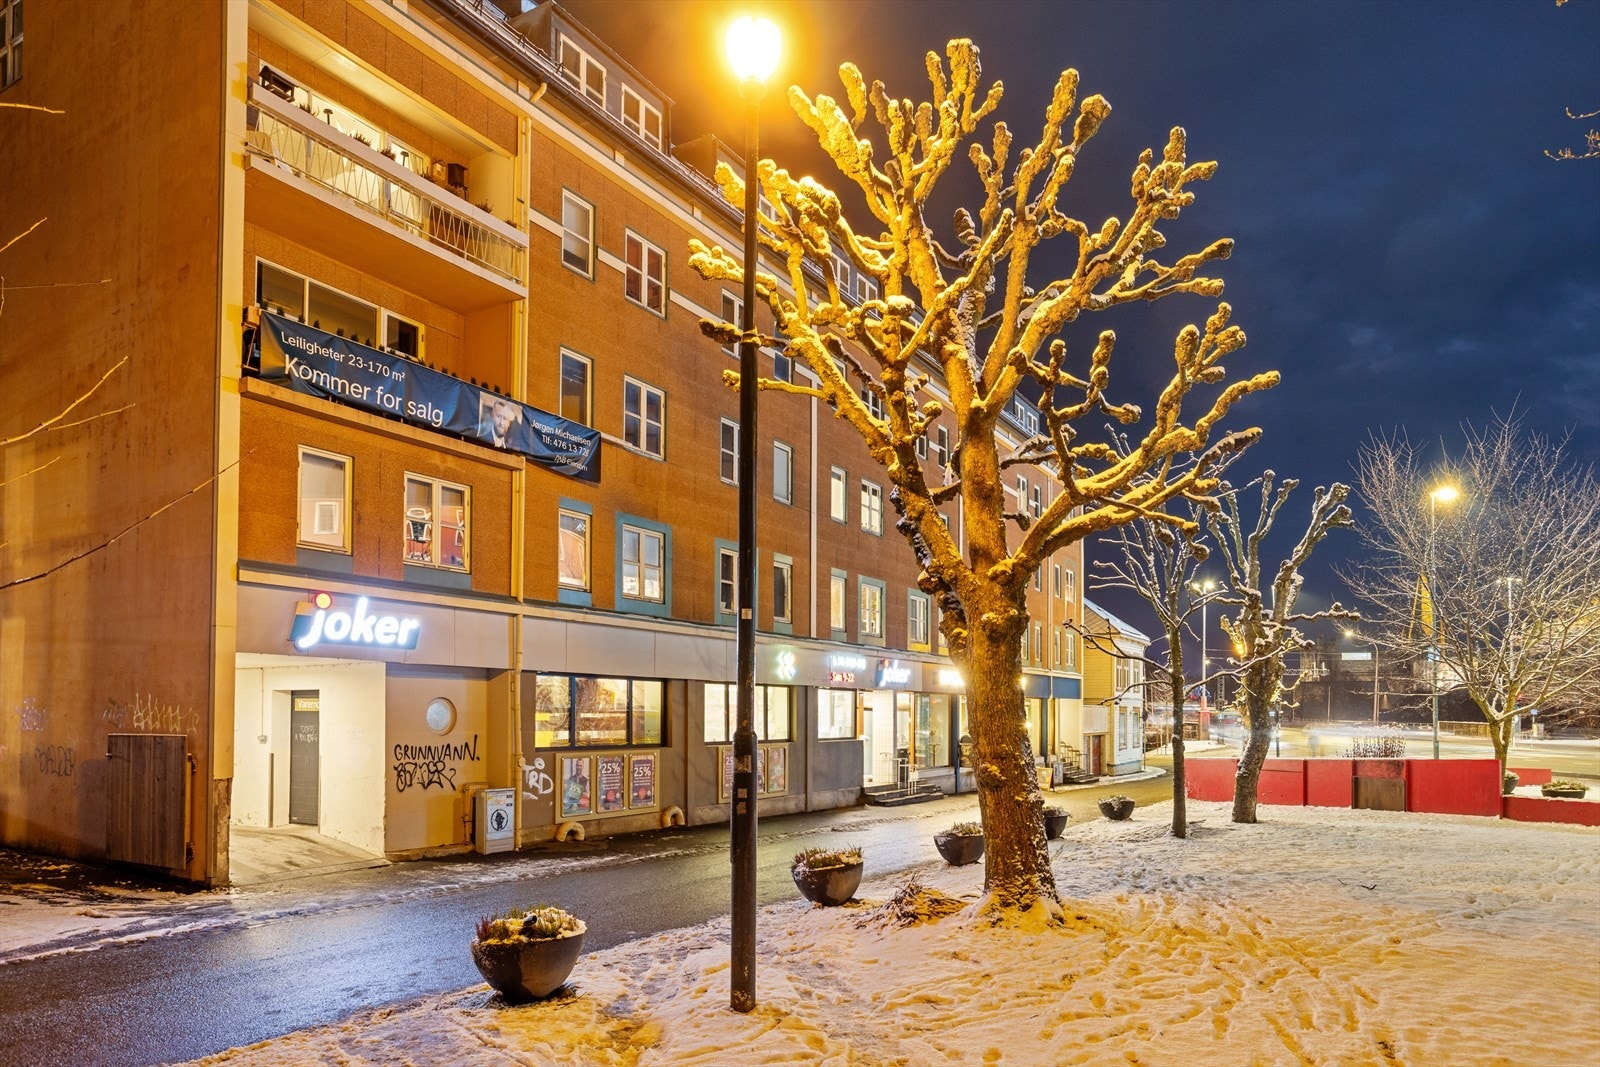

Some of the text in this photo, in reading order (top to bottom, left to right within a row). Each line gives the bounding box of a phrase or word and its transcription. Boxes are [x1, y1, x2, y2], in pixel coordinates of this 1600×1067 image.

[281, 331, 345, 362] Leiligheter
[348, 354, 390, 377] 23-170
[284, 354, 444, 427] Kommer for salg
[531, 419, 554, 434] Jørgen
[542, 434, 552, 445] Tlf:
[553, 439, 567, 450] 476
[568, 444, 577, 453] 13
[297, 592, 419, 649] joker
[879, 657, 910, 687] joker
[394, 734, 480, 761] GRUNNVANN.
[601, 762, 621, 774] 25%
[634, 766, 651, 777] 25%
